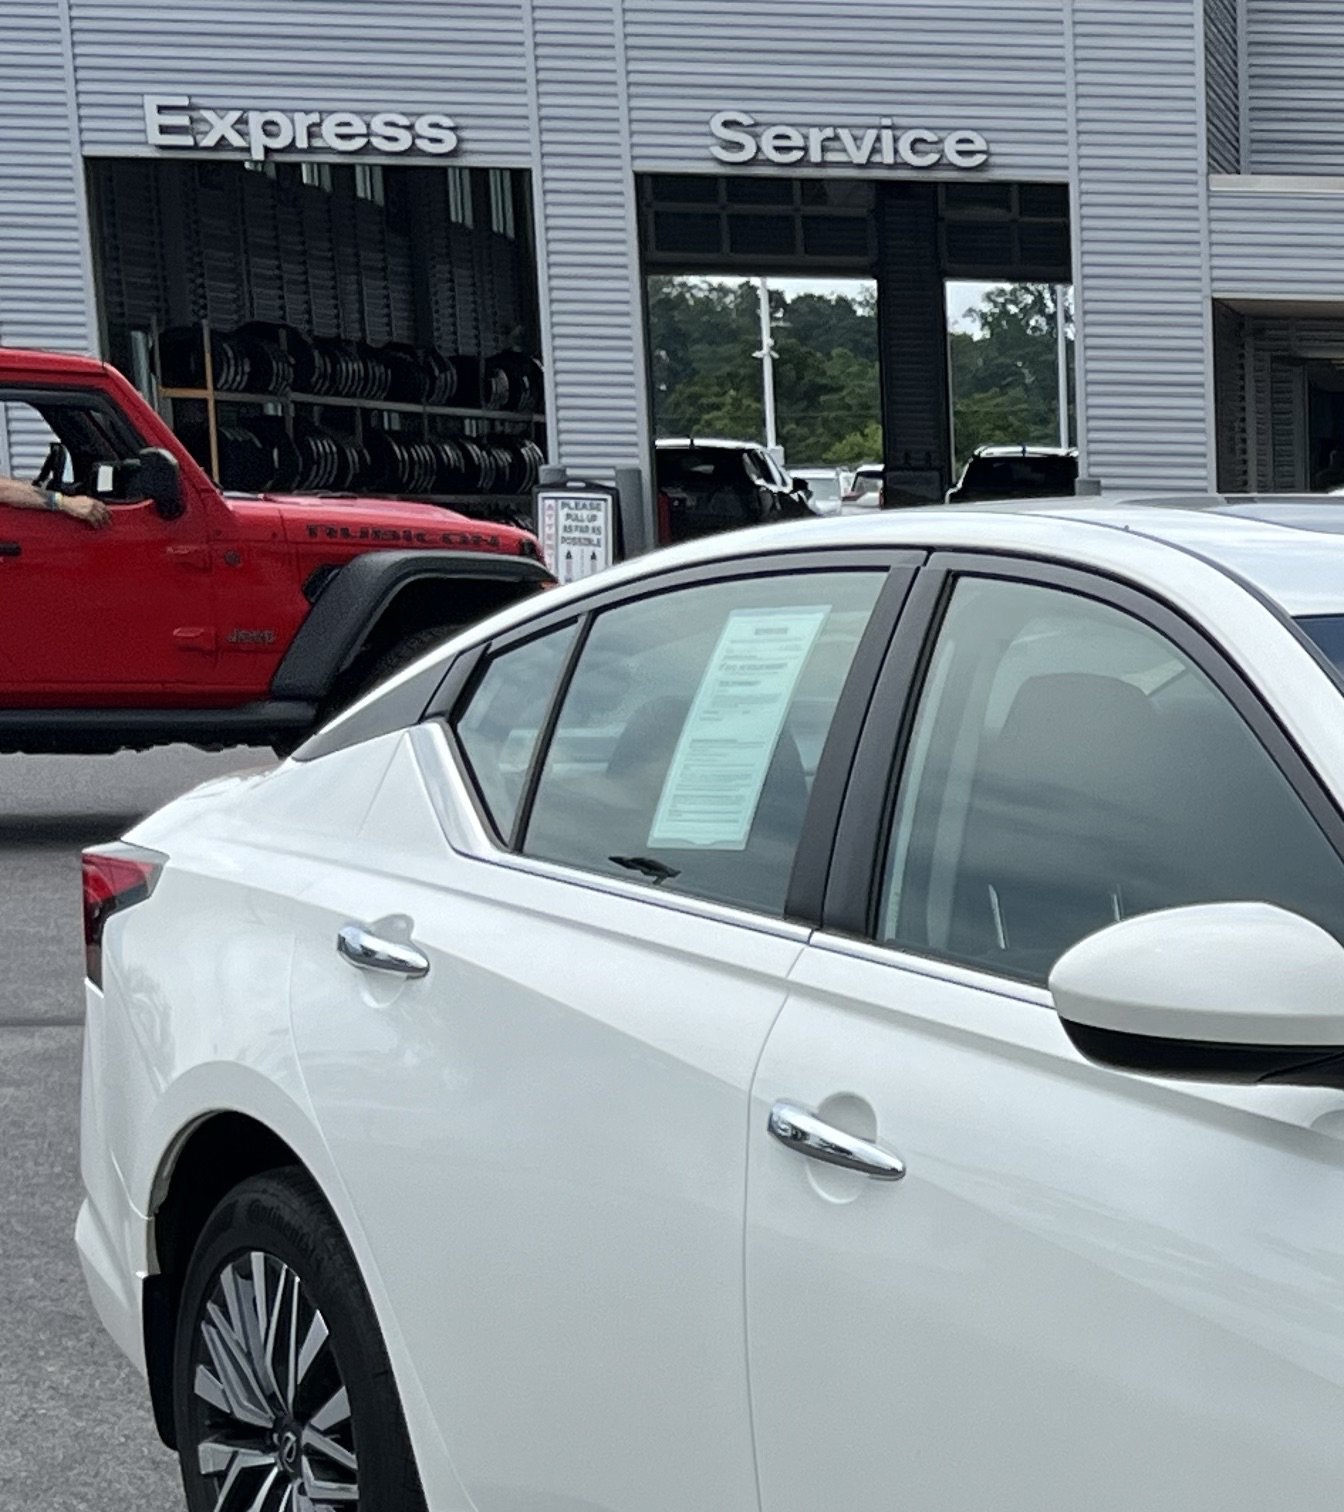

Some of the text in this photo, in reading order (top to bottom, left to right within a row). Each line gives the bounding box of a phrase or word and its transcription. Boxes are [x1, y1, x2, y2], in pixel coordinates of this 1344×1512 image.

[143, 94, 459, 161] Express
[709, 110, 988, 167] Service
[561, 501, 602, 511] PLEASE
